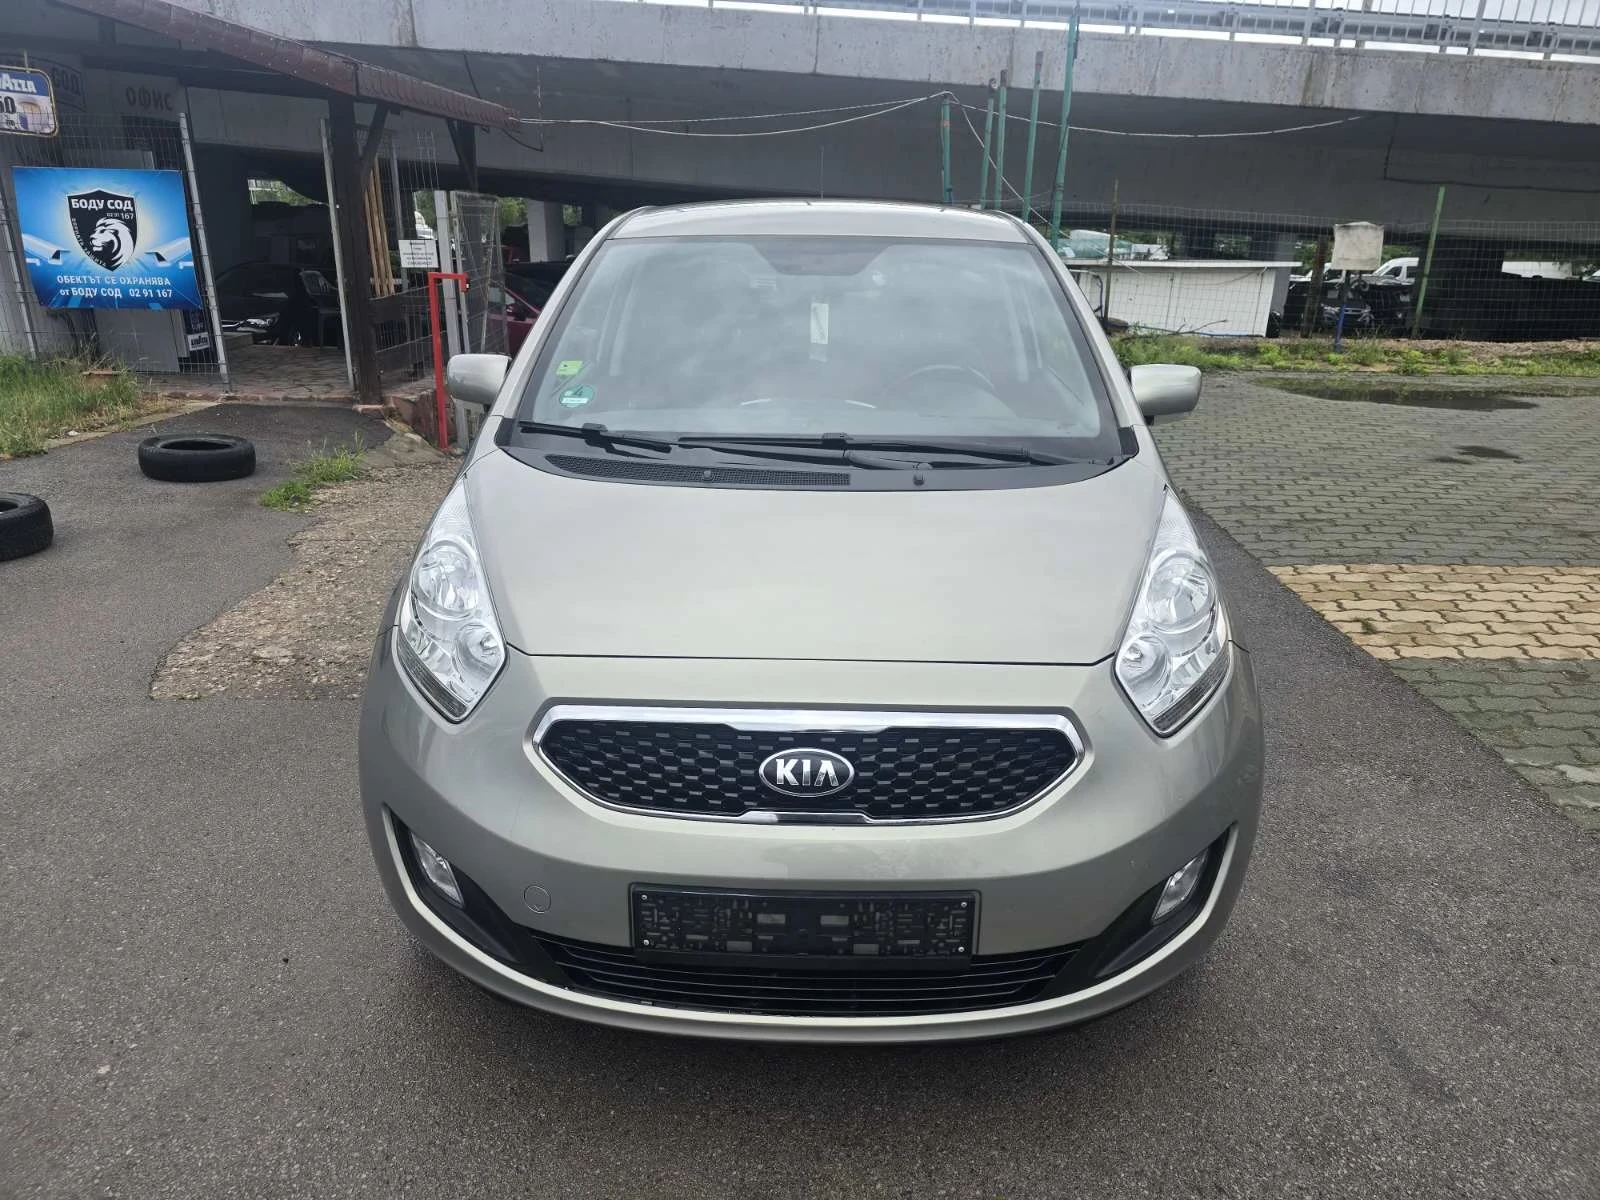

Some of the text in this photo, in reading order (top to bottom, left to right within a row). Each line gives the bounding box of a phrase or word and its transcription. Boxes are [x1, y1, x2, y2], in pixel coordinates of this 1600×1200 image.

[0, 72, 37, 94] AZZA
[125, 85, 172, 112] ОФИС
[71, 198, 134, 212] БОДУ СОД
[121, 212, 134, 220] 167
[56, 275, 171, 287] ОБЕКТЪТ СЕ ОХРАНЯВА
[71, 287, 98, 298] БОДУ
[101, 288, 122, 298] СОД
[129, 289, 141, 297] 02
[142, 289, 153, 298] 91
[156, 289, 172, 298] 167
[775, 758, 839, 787] KIA
